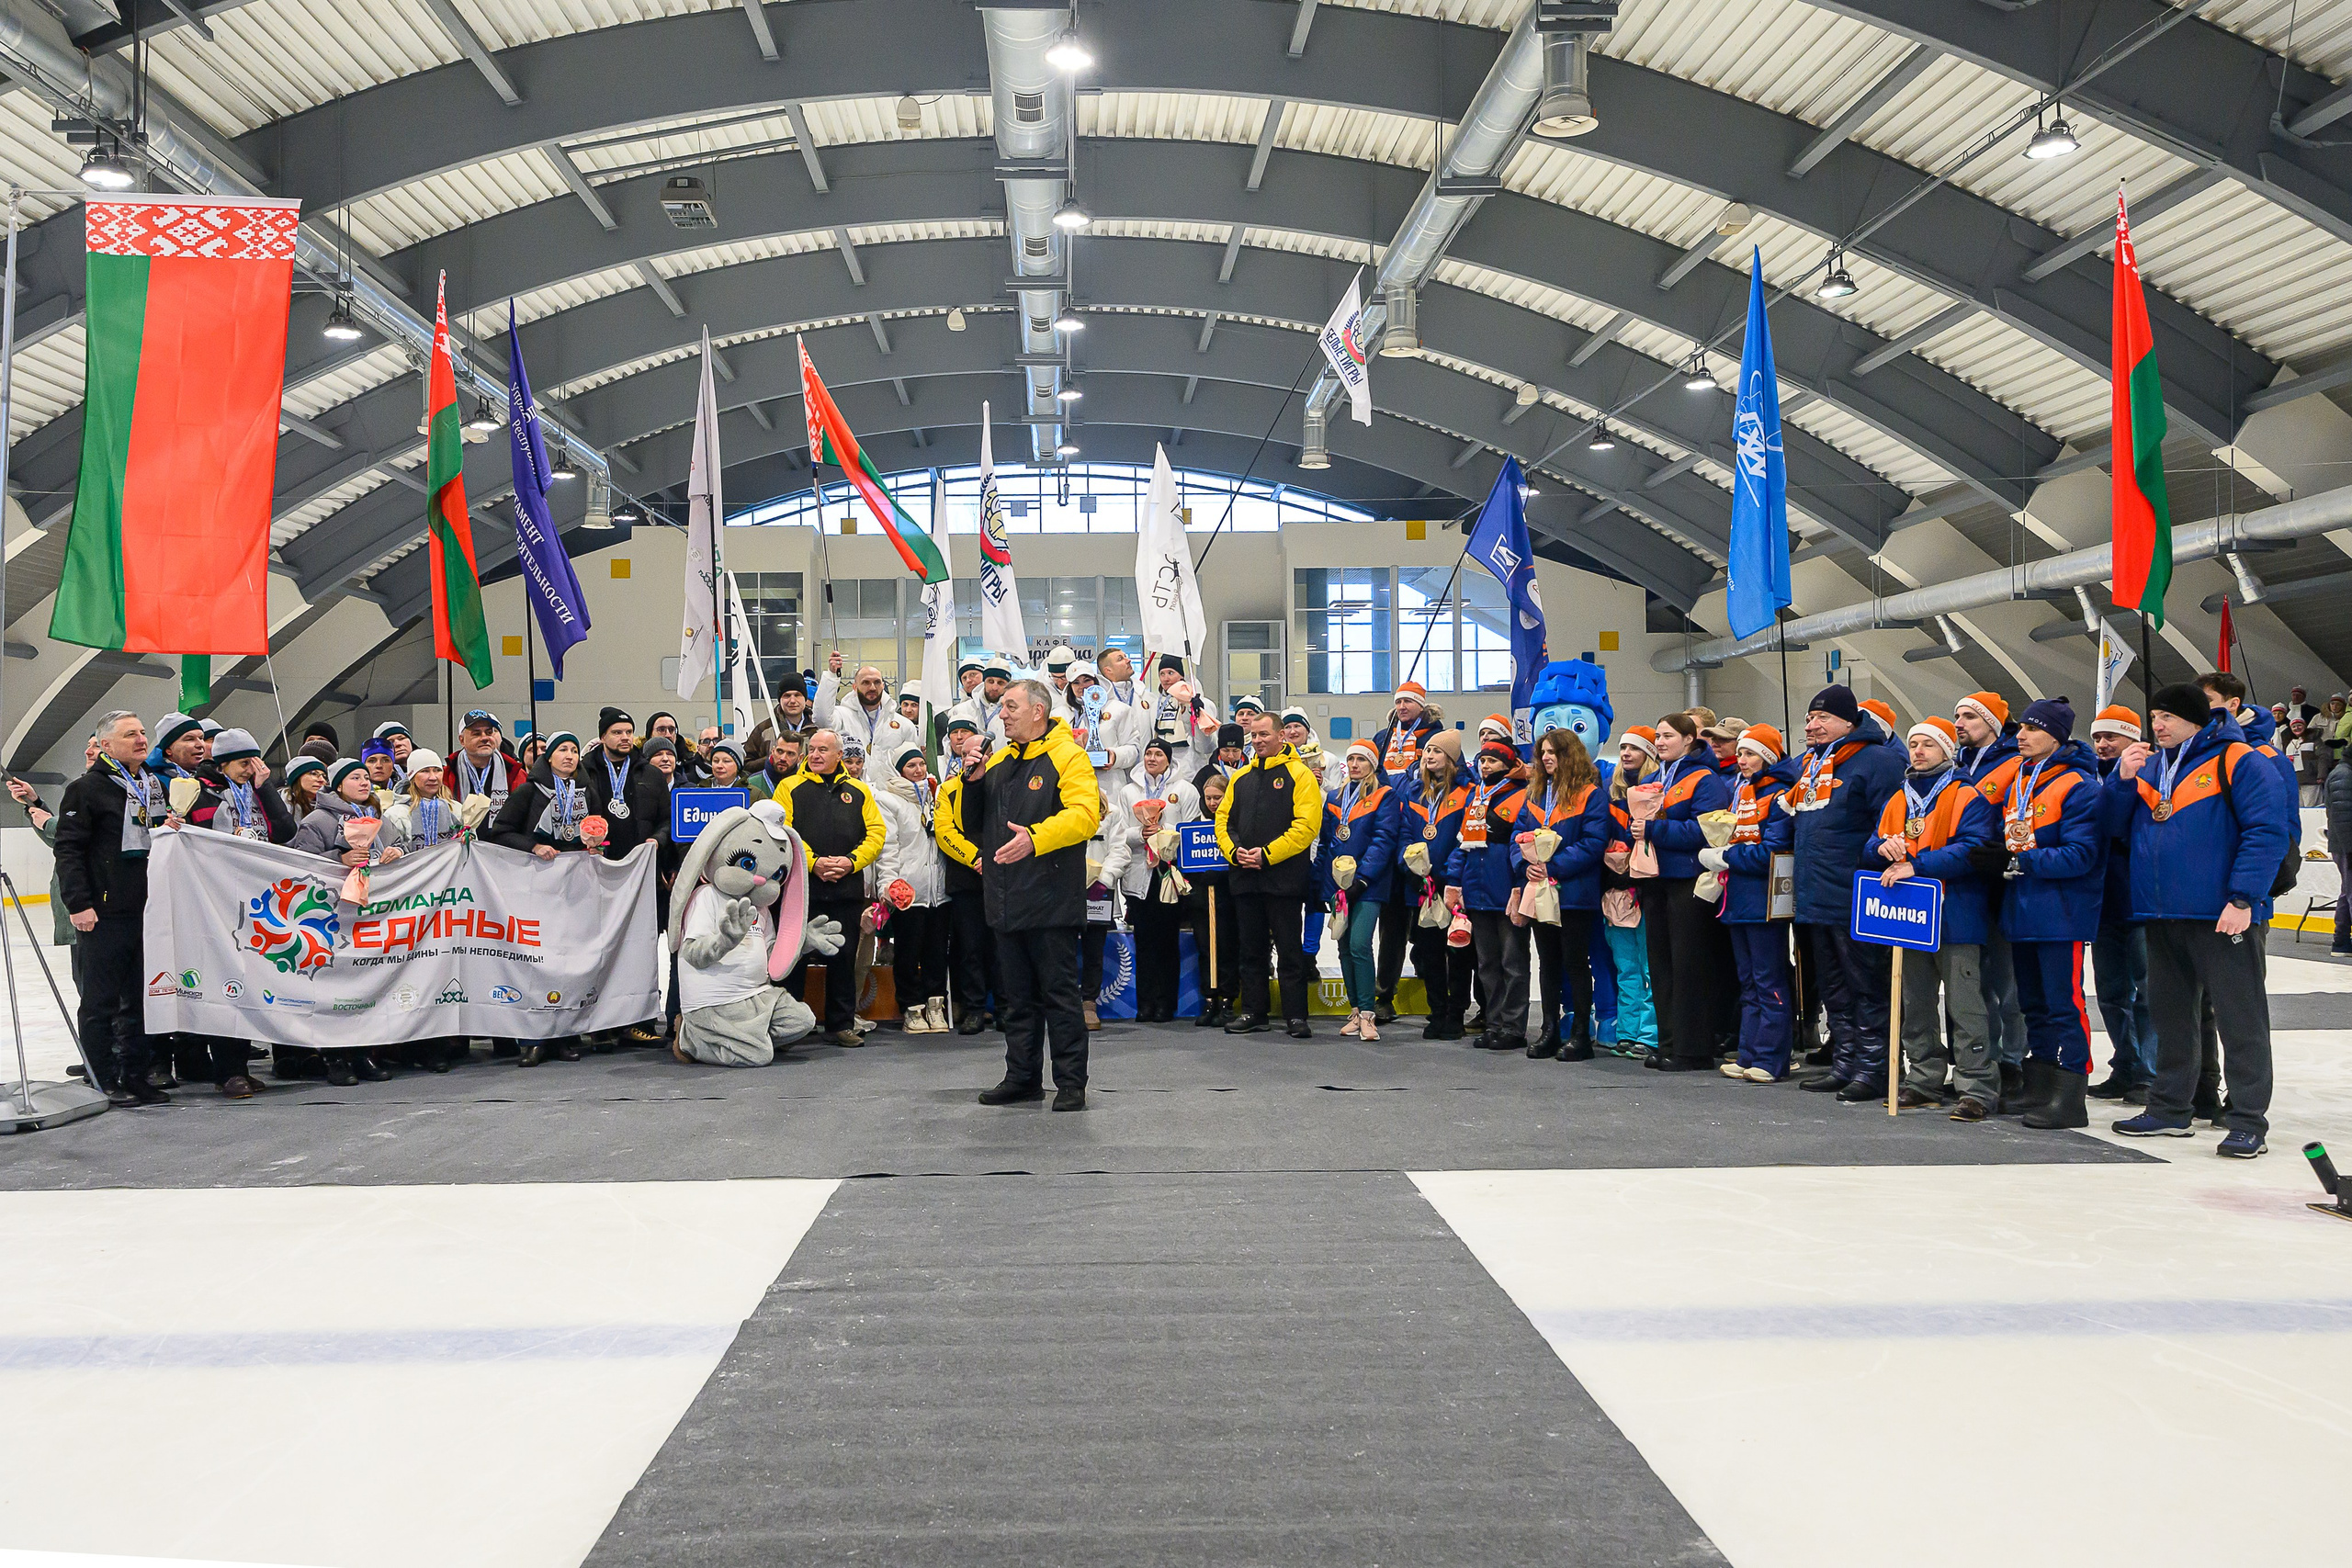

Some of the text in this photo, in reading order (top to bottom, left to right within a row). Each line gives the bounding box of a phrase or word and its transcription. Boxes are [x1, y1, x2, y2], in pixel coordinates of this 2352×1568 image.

[1340, 354, 1364, 386] ТИГРЫ
[1036, 638, 1068, 647] КАФЕ
[2028, 716, 2047, 728] MOAX
[683, 807, 722, 823] Един
[1191, 846, 1224, 861] тигр
[357, 886, 475, 917] КОМАНДА
[1865, 897, 1928, 925] Молния
[352, 908, 542, 954] ЕДИНЫЕ
[352, 956, 385, 967] КОГДА
[387, 954, 405, 965] МЫ
[451, 946, 468, 955] МЫ
[469, 947, 545, 964] НЕПОБЕДИМЫ!
[333, 999, 377, 1010] ВОСТОЧНЫЙ
